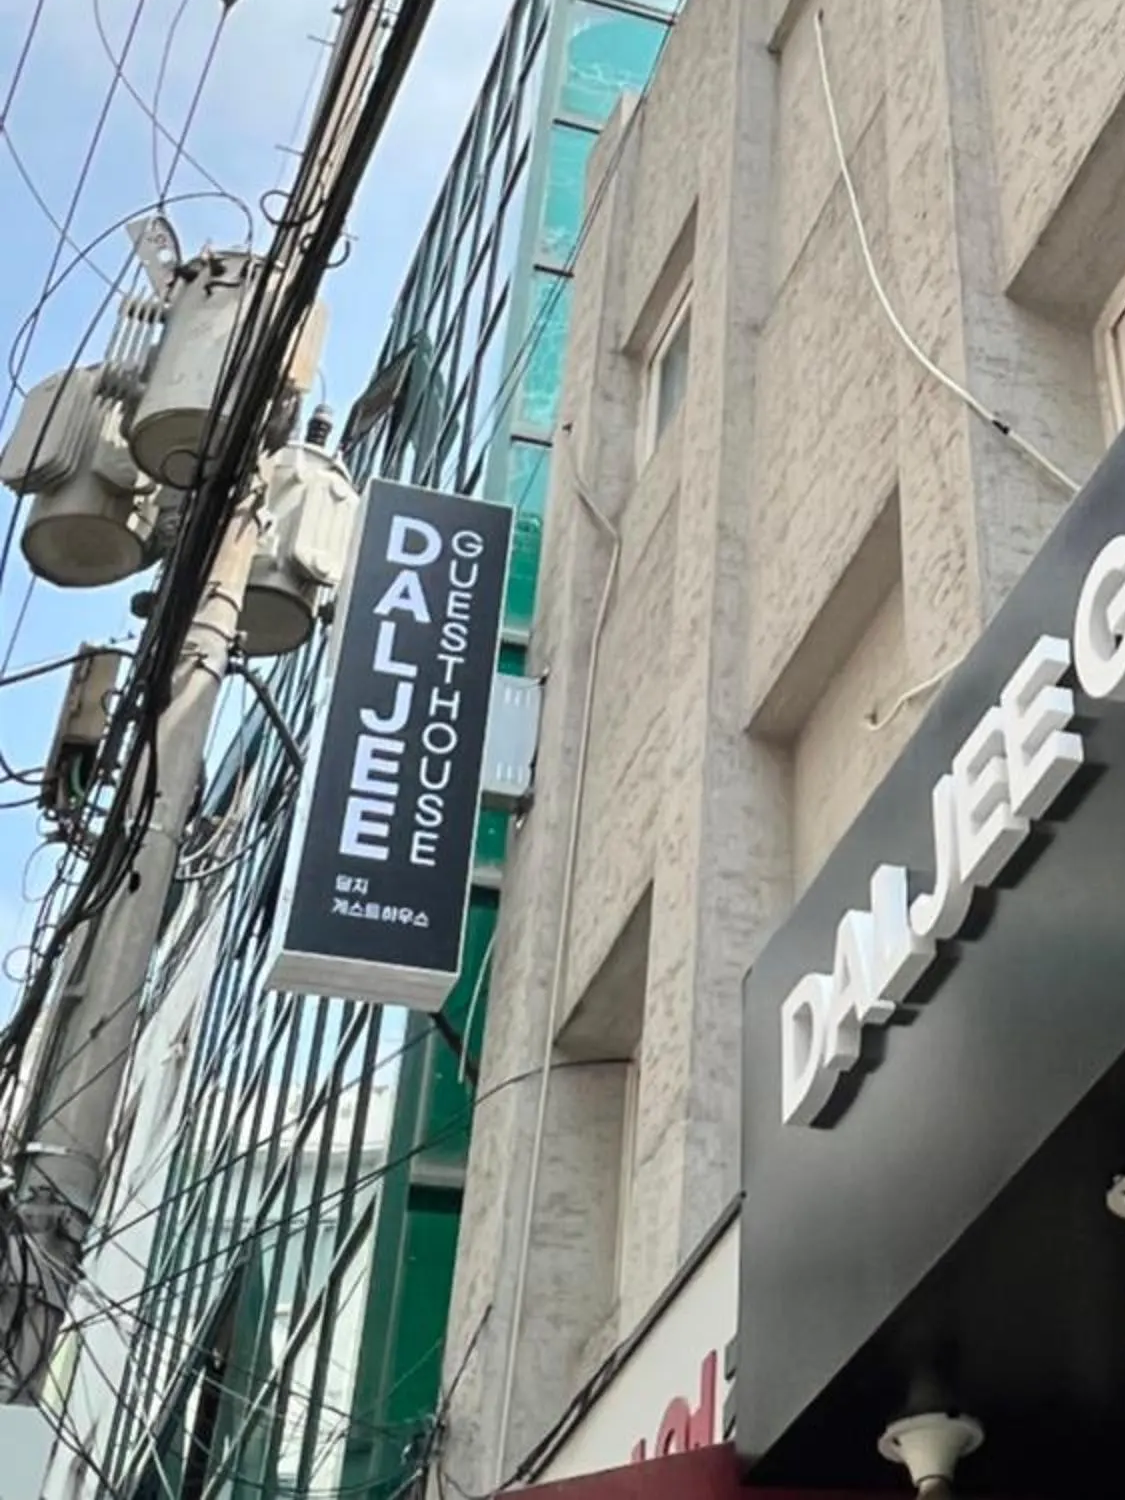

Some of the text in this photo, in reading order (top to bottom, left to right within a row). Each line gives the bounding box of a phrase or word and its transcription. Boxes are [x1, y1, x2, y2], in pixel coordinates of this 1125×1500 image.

[339, 515, 443, 861] DALJEE
[410, 531, 484, 867] GUESTHOUSE
[331, 897, 430, 928] 게스트하우스
[782, 634, 1083, 1125] DALJEE
